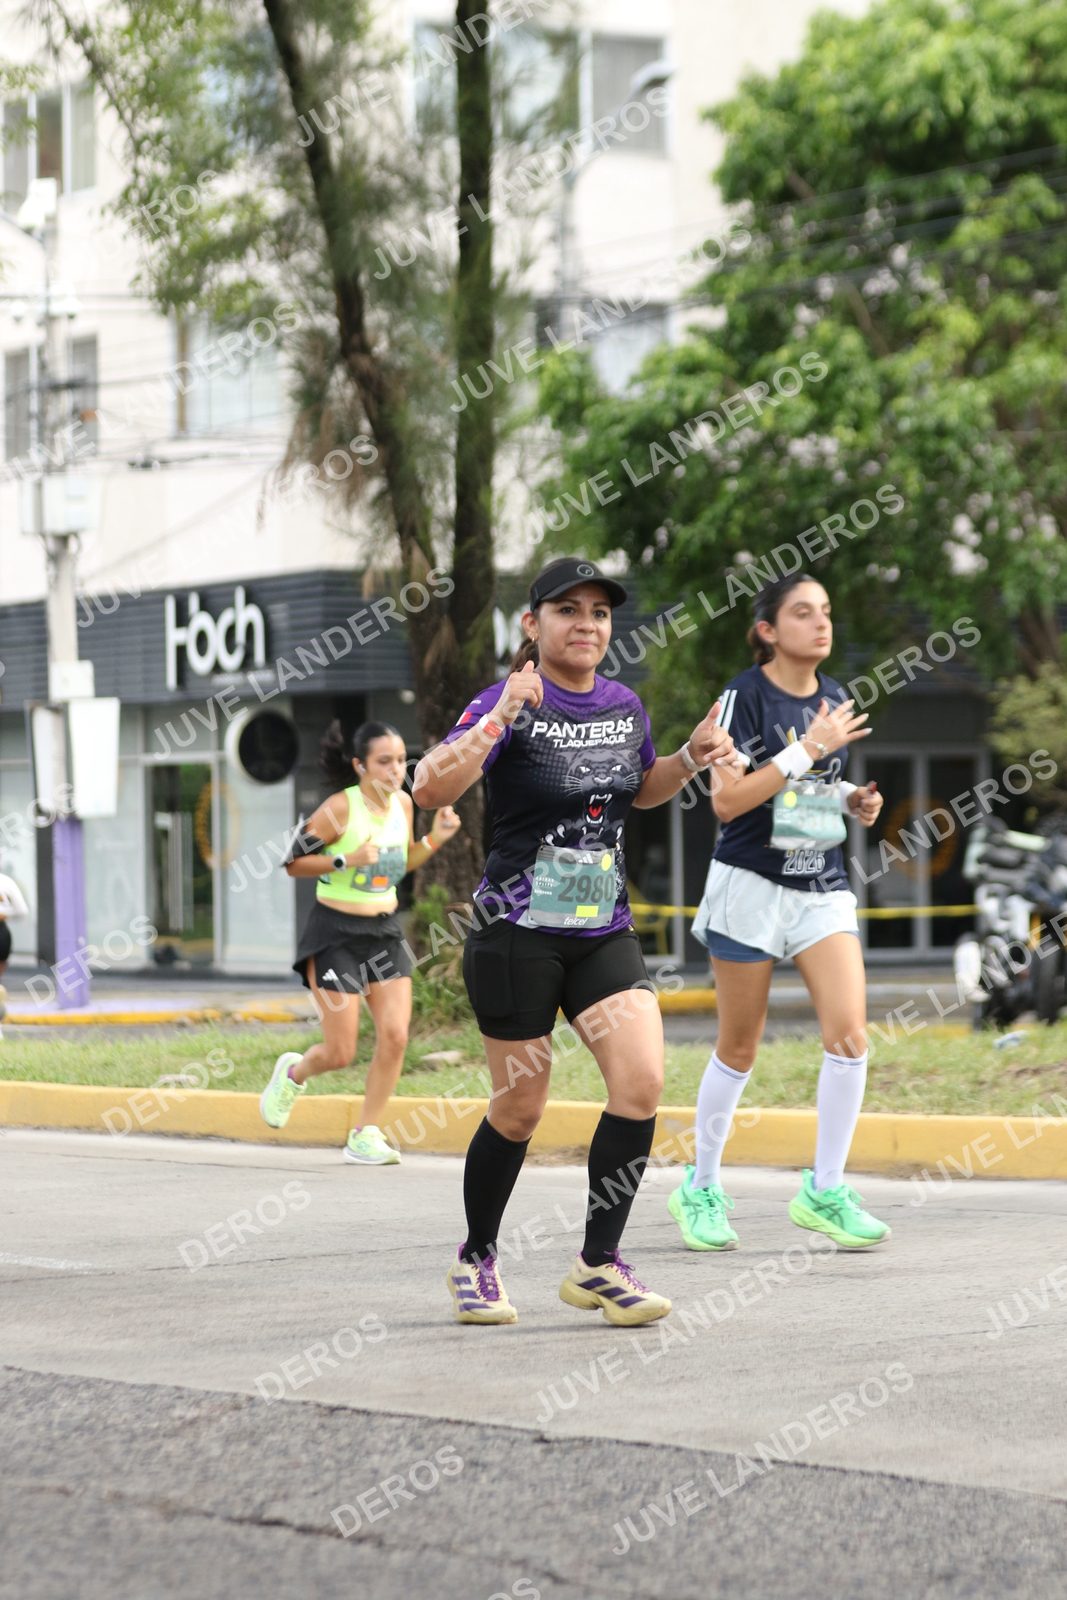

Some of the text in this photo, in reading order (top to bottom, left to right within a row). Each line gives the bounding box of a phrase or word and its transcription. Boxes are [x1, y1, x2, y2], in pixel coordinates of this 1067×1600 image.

[531, 716, 635, 738] PANTERAS
[553, 734, 626, 749] TLAQUEPAQUE
[558, 873, 615, 903] 2980
